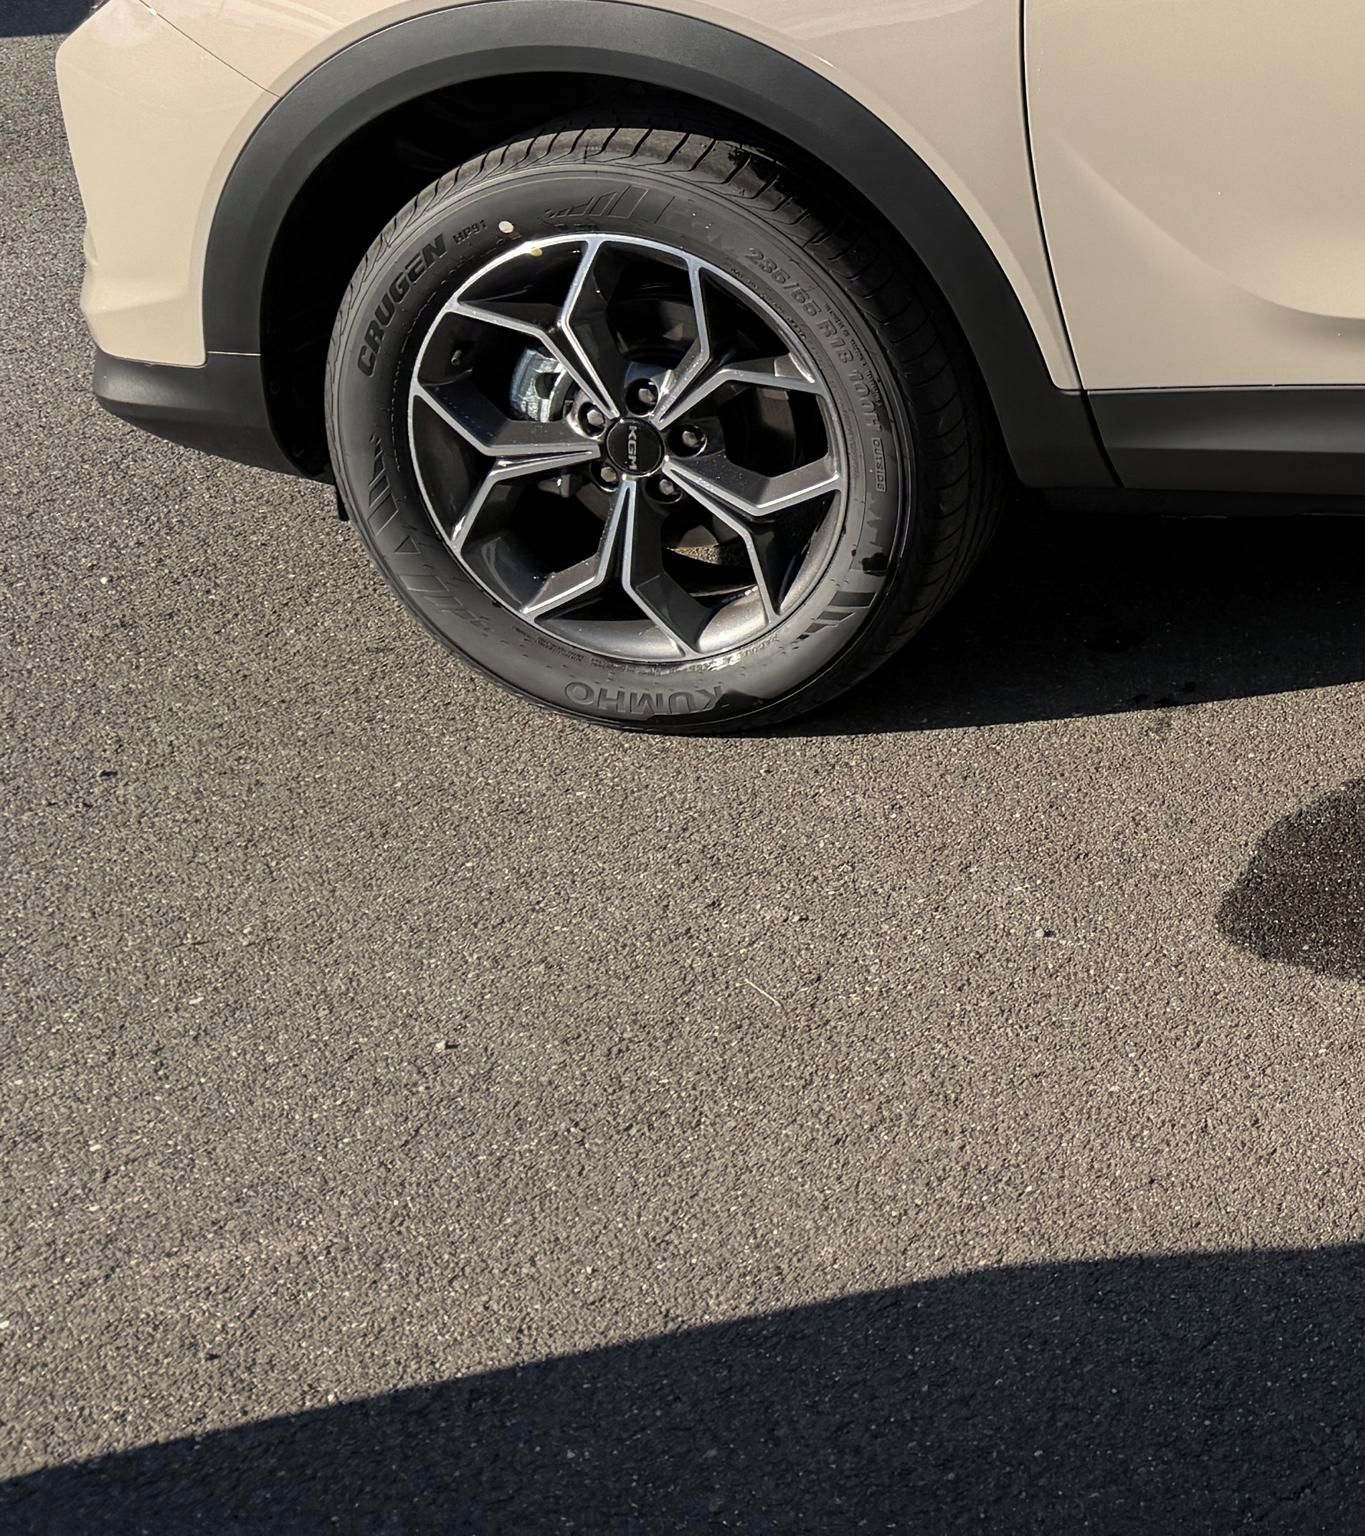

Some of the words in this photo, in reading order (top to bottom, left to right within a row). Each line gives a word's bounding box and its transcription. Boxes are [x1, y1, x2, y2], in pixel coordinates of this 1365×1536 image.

[357, 233, 448, 378] CRUGEN
[452, 219, 487, 245] HP91
[628, 425, 638, 470] KGM
[564, 681, 724, 715] KUMHO
